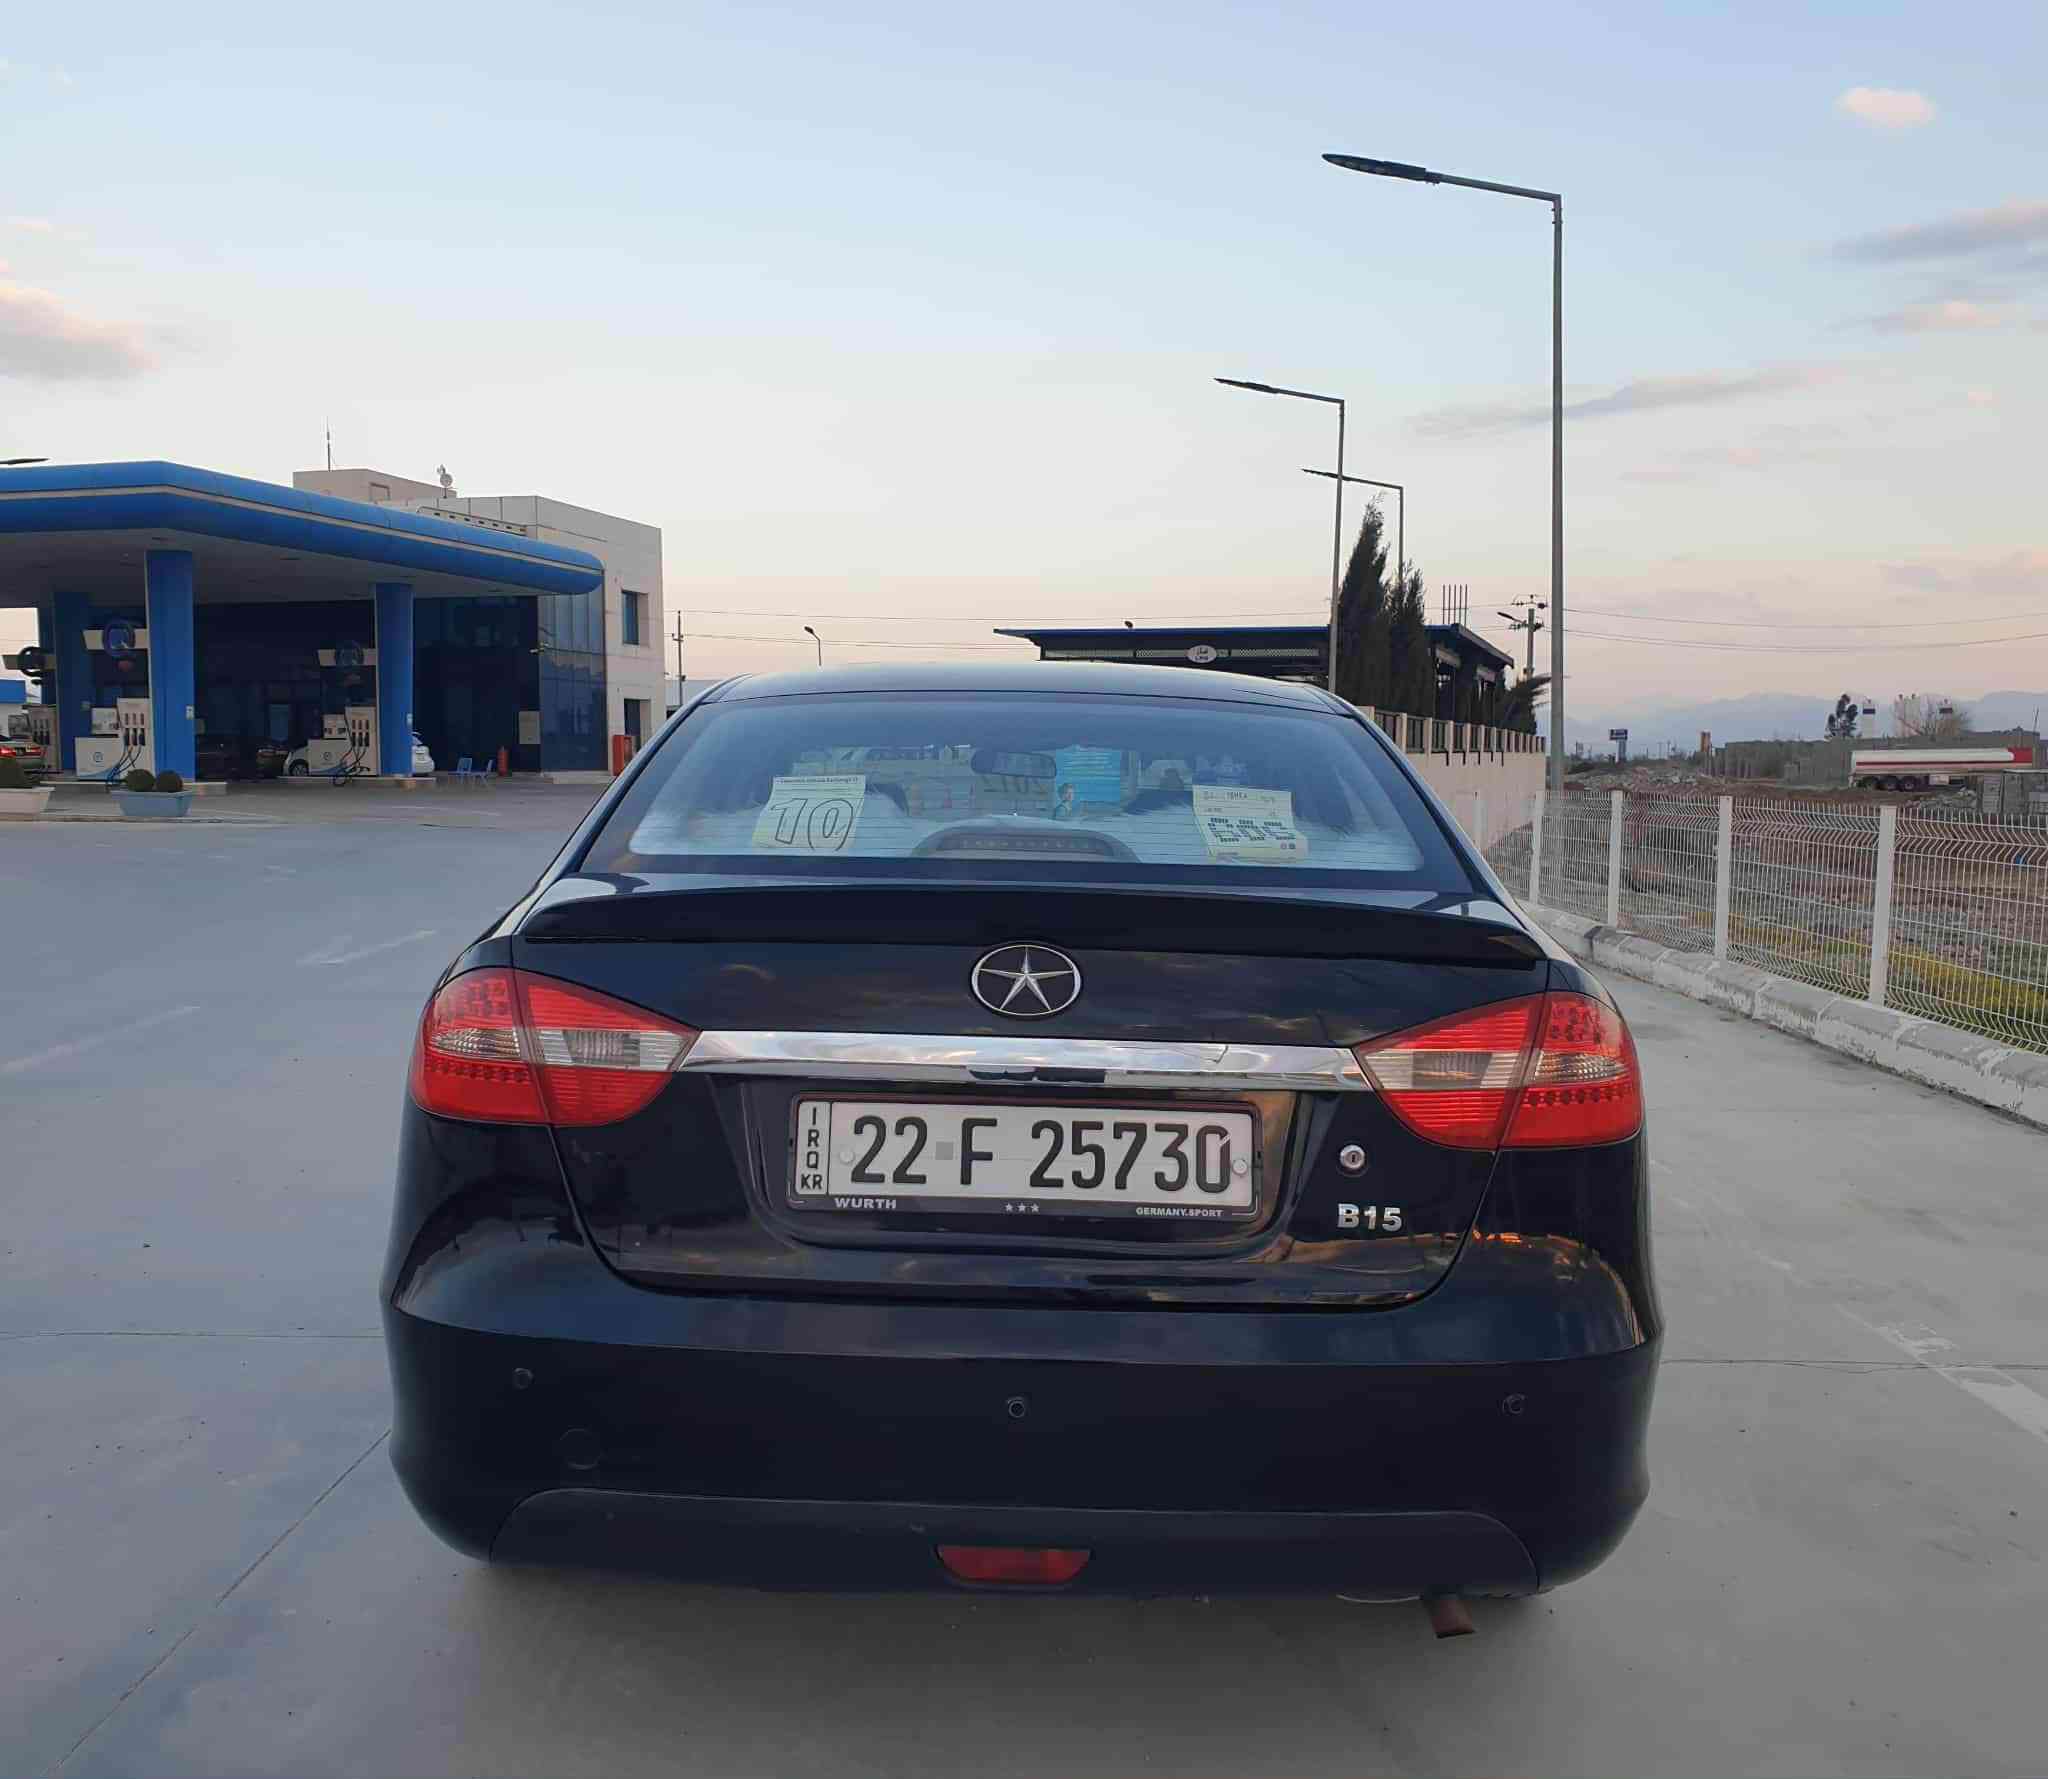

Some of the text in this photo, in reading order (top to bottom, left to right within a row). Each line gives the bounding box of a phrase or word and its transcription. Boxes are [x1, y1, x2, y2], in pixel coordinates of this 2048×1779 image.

[850, 1114, 1231, 1194] 22 F 25730
[800, 1173, 823, 1190] KR
[834, 1197, 897, 1210] WURTH
[1336, 1202, 1403, 1232] B15
